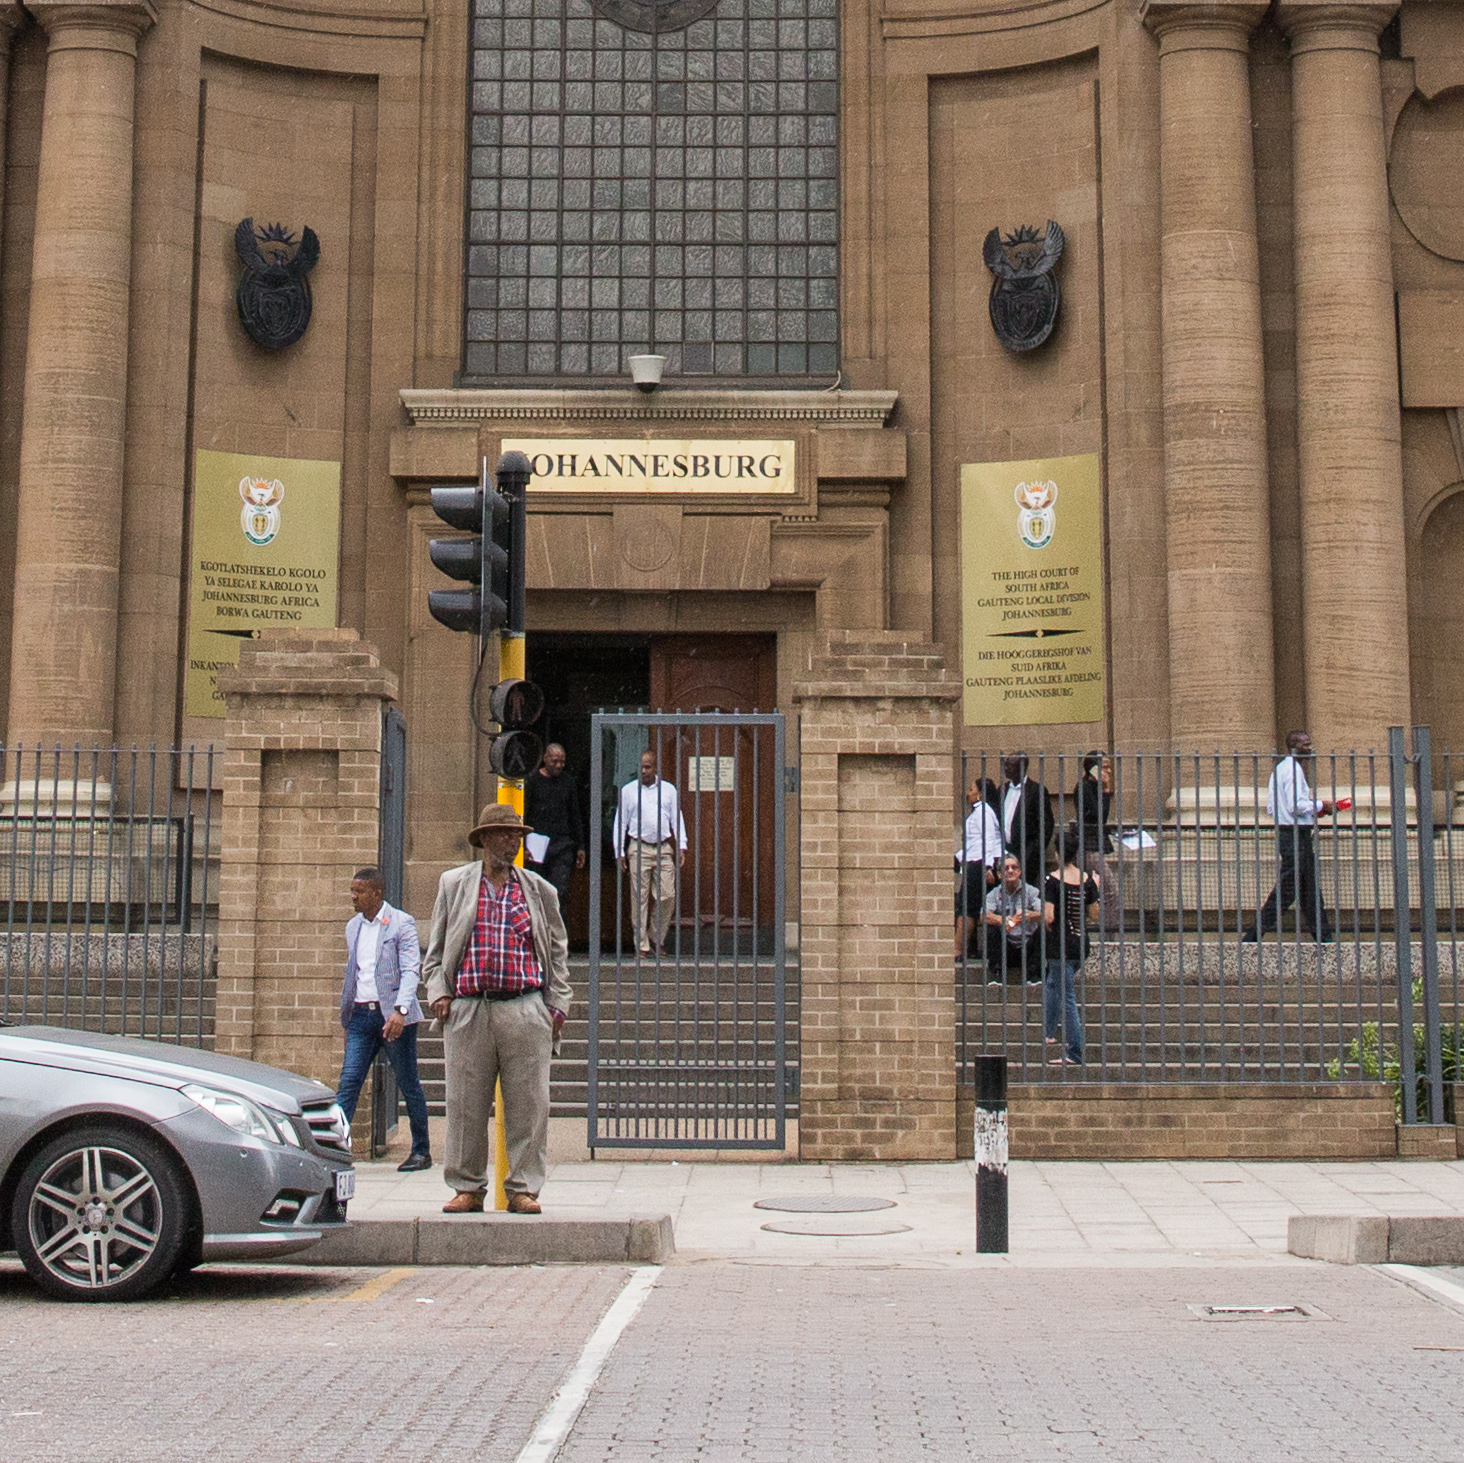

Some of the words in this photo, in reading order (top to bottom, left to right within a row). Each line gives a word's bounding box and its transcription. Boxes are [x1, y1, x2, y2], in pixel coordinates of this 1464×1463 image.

[524, 453, 782, 478] OHANNESBURG
[200, 561, 286, 577] KGOTLATSHEKELO
[289, 568, 326, 579] KGOLO
[992, 571, 1012, 581] THE
[1013, 570, 1038, 580] HIGH
[1040, 568, 1068, 579] COURT
[1069, 567, 1080, 576] OF
[205, 576, 215, 586] YA
[218, 577, 257, 589] SELEGAE
[260, 580, 303, 592] KAROLO
[305, 583, 319, 593] YA
[1005, 583, 1037, 593] SOUTH
[1039, 581, 1069, 591] AFRICA
[202, 591, 278, 605] JOHANNESBURG
[281, 597, 320, 607] AFRICA
[977, 596, 1024, 607] GAUTENG
[1026, 595, 1055, 605] LOCAL
[1056, 592, 1091, 603] DIVISION
[216, 606, 249, 618] BORWA
[251, 609, 302, 621] GAUTENG
[1002, 607, 1072, 621] JOHANNESBURG
[978, 651, 995, 660] DIE
[1075, 646, 1092, 655] VAN
[1011, 663, 1034, 672] SUID
[1035, 661, 1067, 671] AFRIKA
[966, 677, 1013, 687] GAUTENG
[1015, 674, 1063, 685] PLAASLIKE
[1064, 671, 1102, 683] AFDELING
[1003, 687, 1073, 701] JOHANNESBURG
